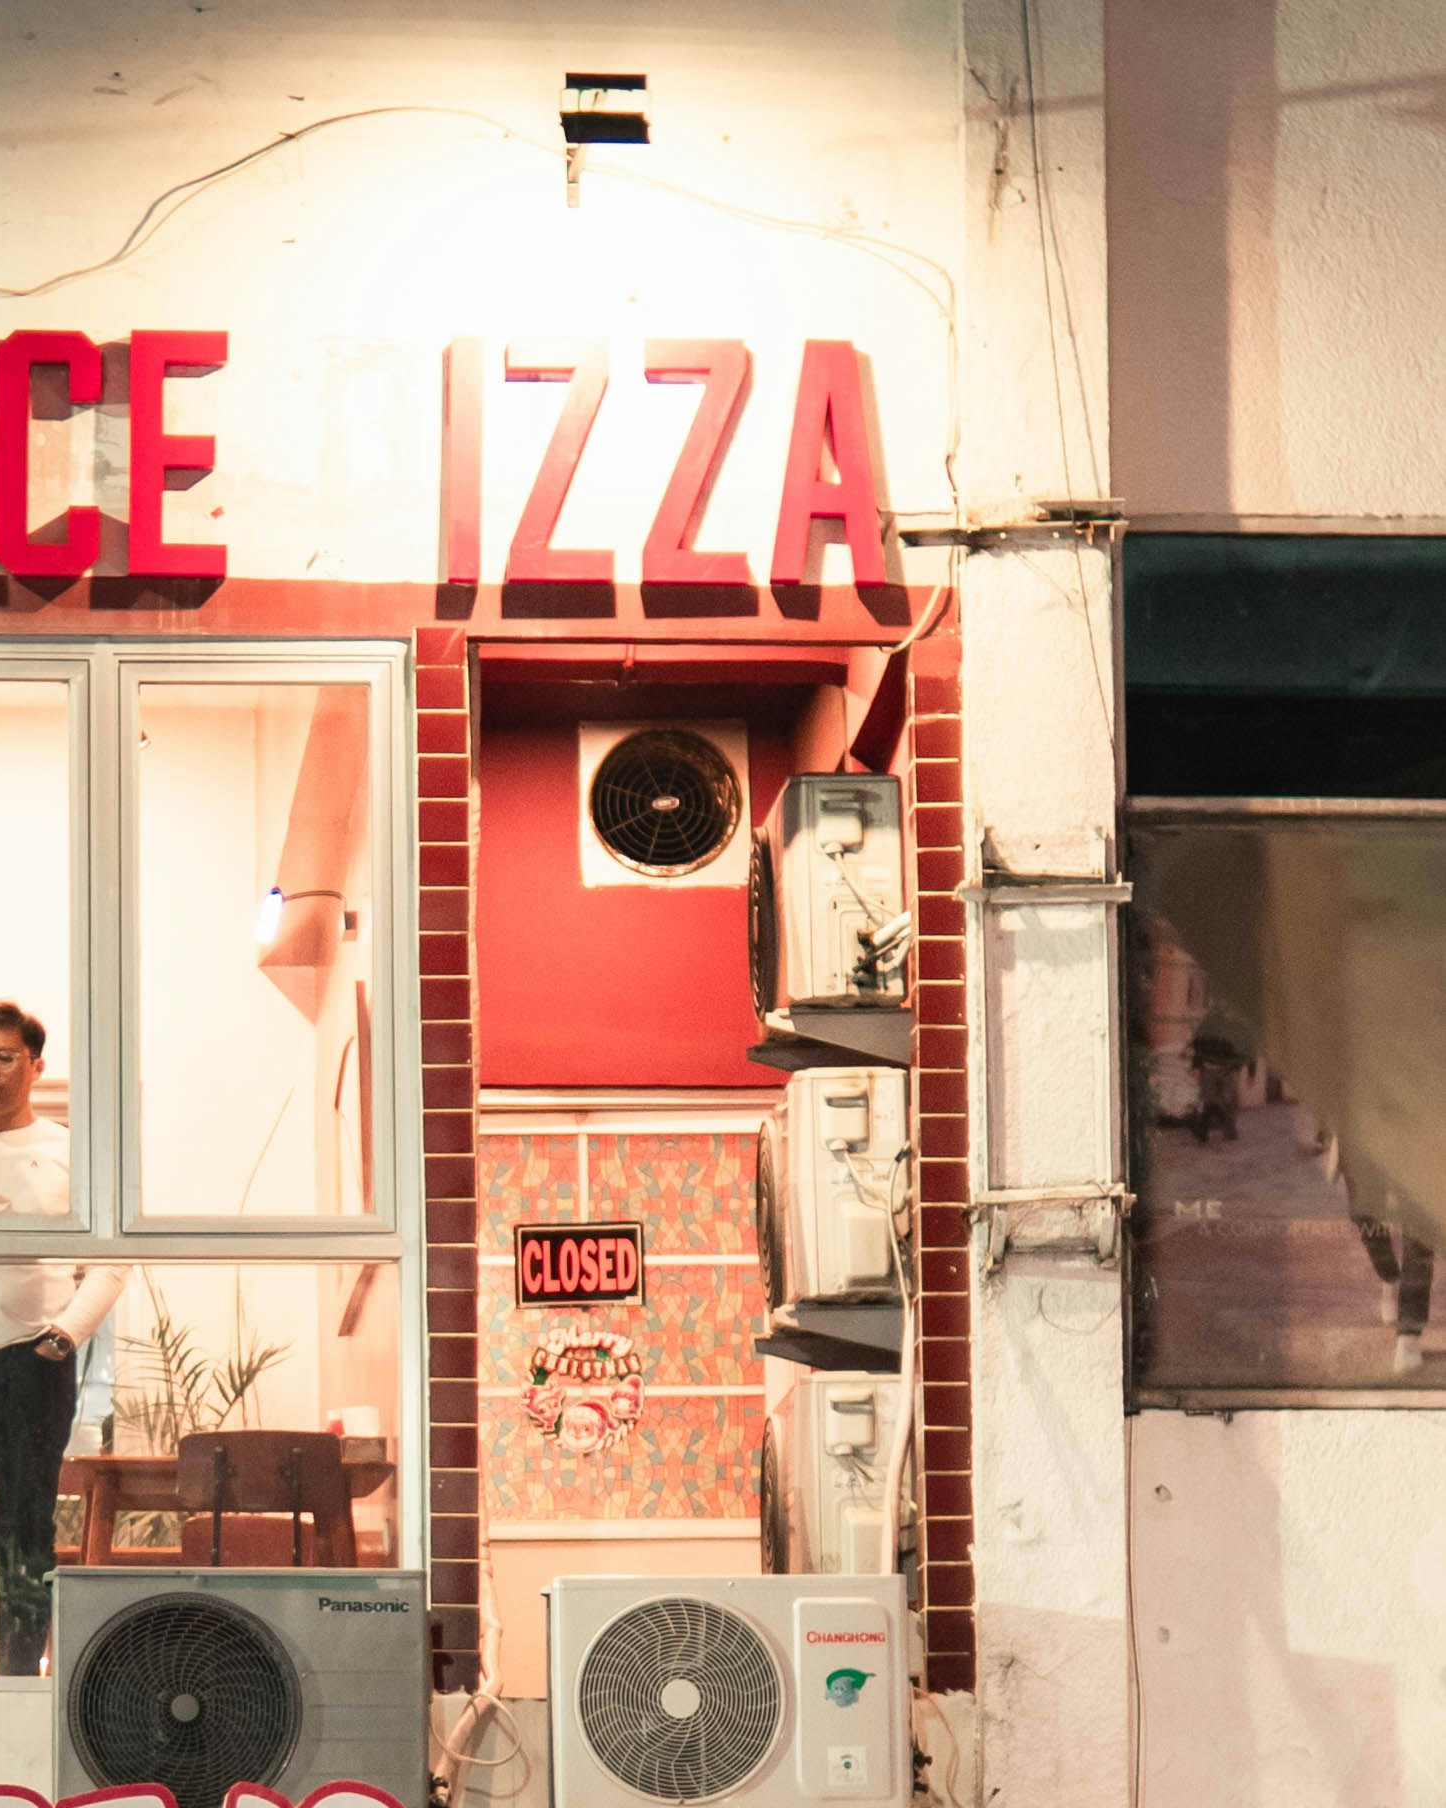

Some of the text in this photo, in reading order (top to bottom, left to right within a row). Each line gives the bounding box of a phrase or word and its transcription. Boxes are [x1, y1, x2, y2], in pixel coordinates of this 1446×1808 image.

[522, 1238, 637, 1294] CLOSED
[318, 1597, 410, 1612] Panasonic
[806, 1631, 886, 1644] CHANGHONG
